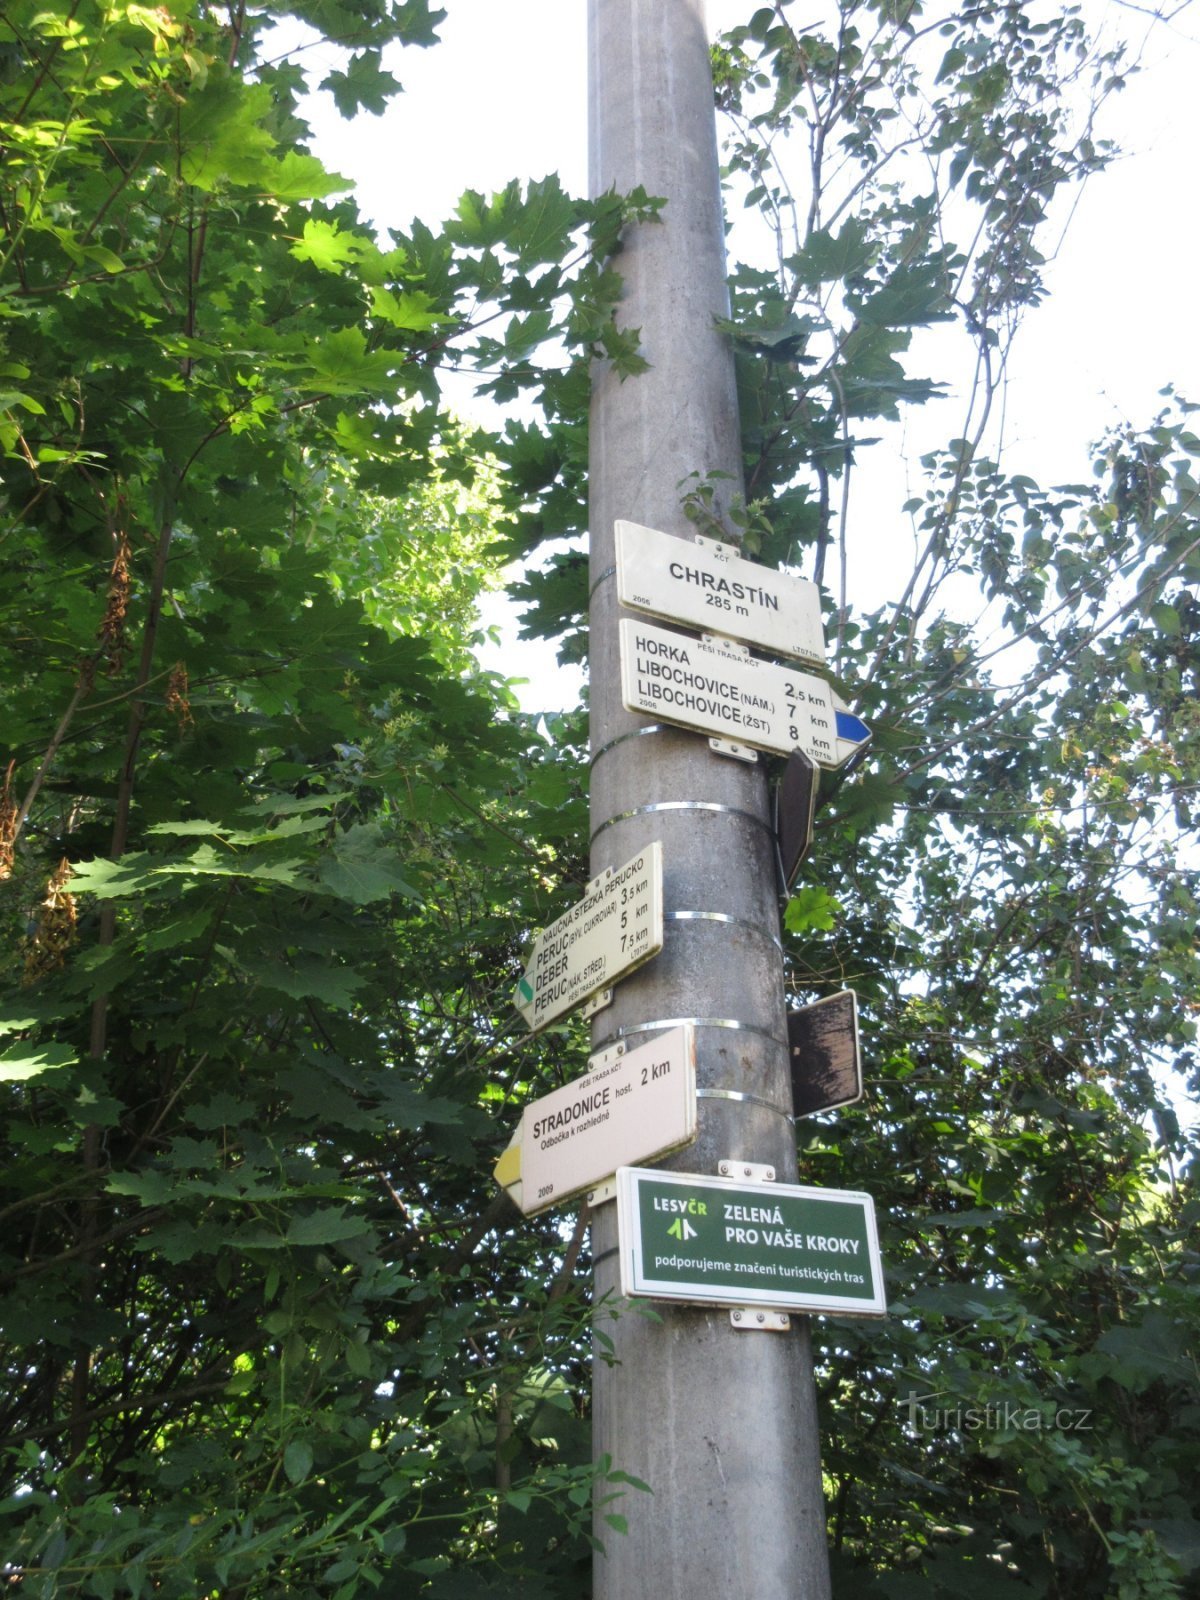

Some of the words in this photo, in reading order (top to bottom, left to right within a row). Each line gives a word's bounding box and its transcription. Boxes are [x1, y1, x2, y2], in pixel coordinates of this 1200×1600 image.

[669, 562, 779, 611] CHRASTÍN
[706, 593, 732, 611] 285
[736, 604, 750, 617] m
[635, 636, 691, 666] HORKA
[636, 657, 739, 700] LIBOCHOVICE
[637, 680, 741, 723] LIBOCHOVICE
[808, 690, 826, 708] km
[786, 704, 797, 719] 7
[810, 714, 828, 729] km
[789, 725, 799, 740] 8
[812, 736, 831, 750] km
[574, 890, 604, 920] STEZKA
[604, 858, 644, 896] PERUCKO
[635, 879, 648, 895] km
[620, 911, 628, 929] 5
[636, 903, 648, 919] km
[635, 927, 648, 943] km
[533, 1087, 610, 1140] STRADONICE
[615, 1083, 633, 1099] host.
[641, 1067, 648, 1086] 2
[652, 1059, 671, 1081] km
[540, 1132, 570, 1151] Odbočka
[570, 1126, 576, 1137] k
[537, 1184, 554, 1199] 2009
[723, 1204, 784, 1225] ZELENÁ
[725, 1227, 759, 1244] PRO
[762, 1228, 803, 1249] VAŠE
[806, 1235, 859, 1255] KROKY
[655, 1254, 732, 1272] podporujeme
[779, 1265, 842, 1283] turistických
[844, 1271, 865, 1284] tras
